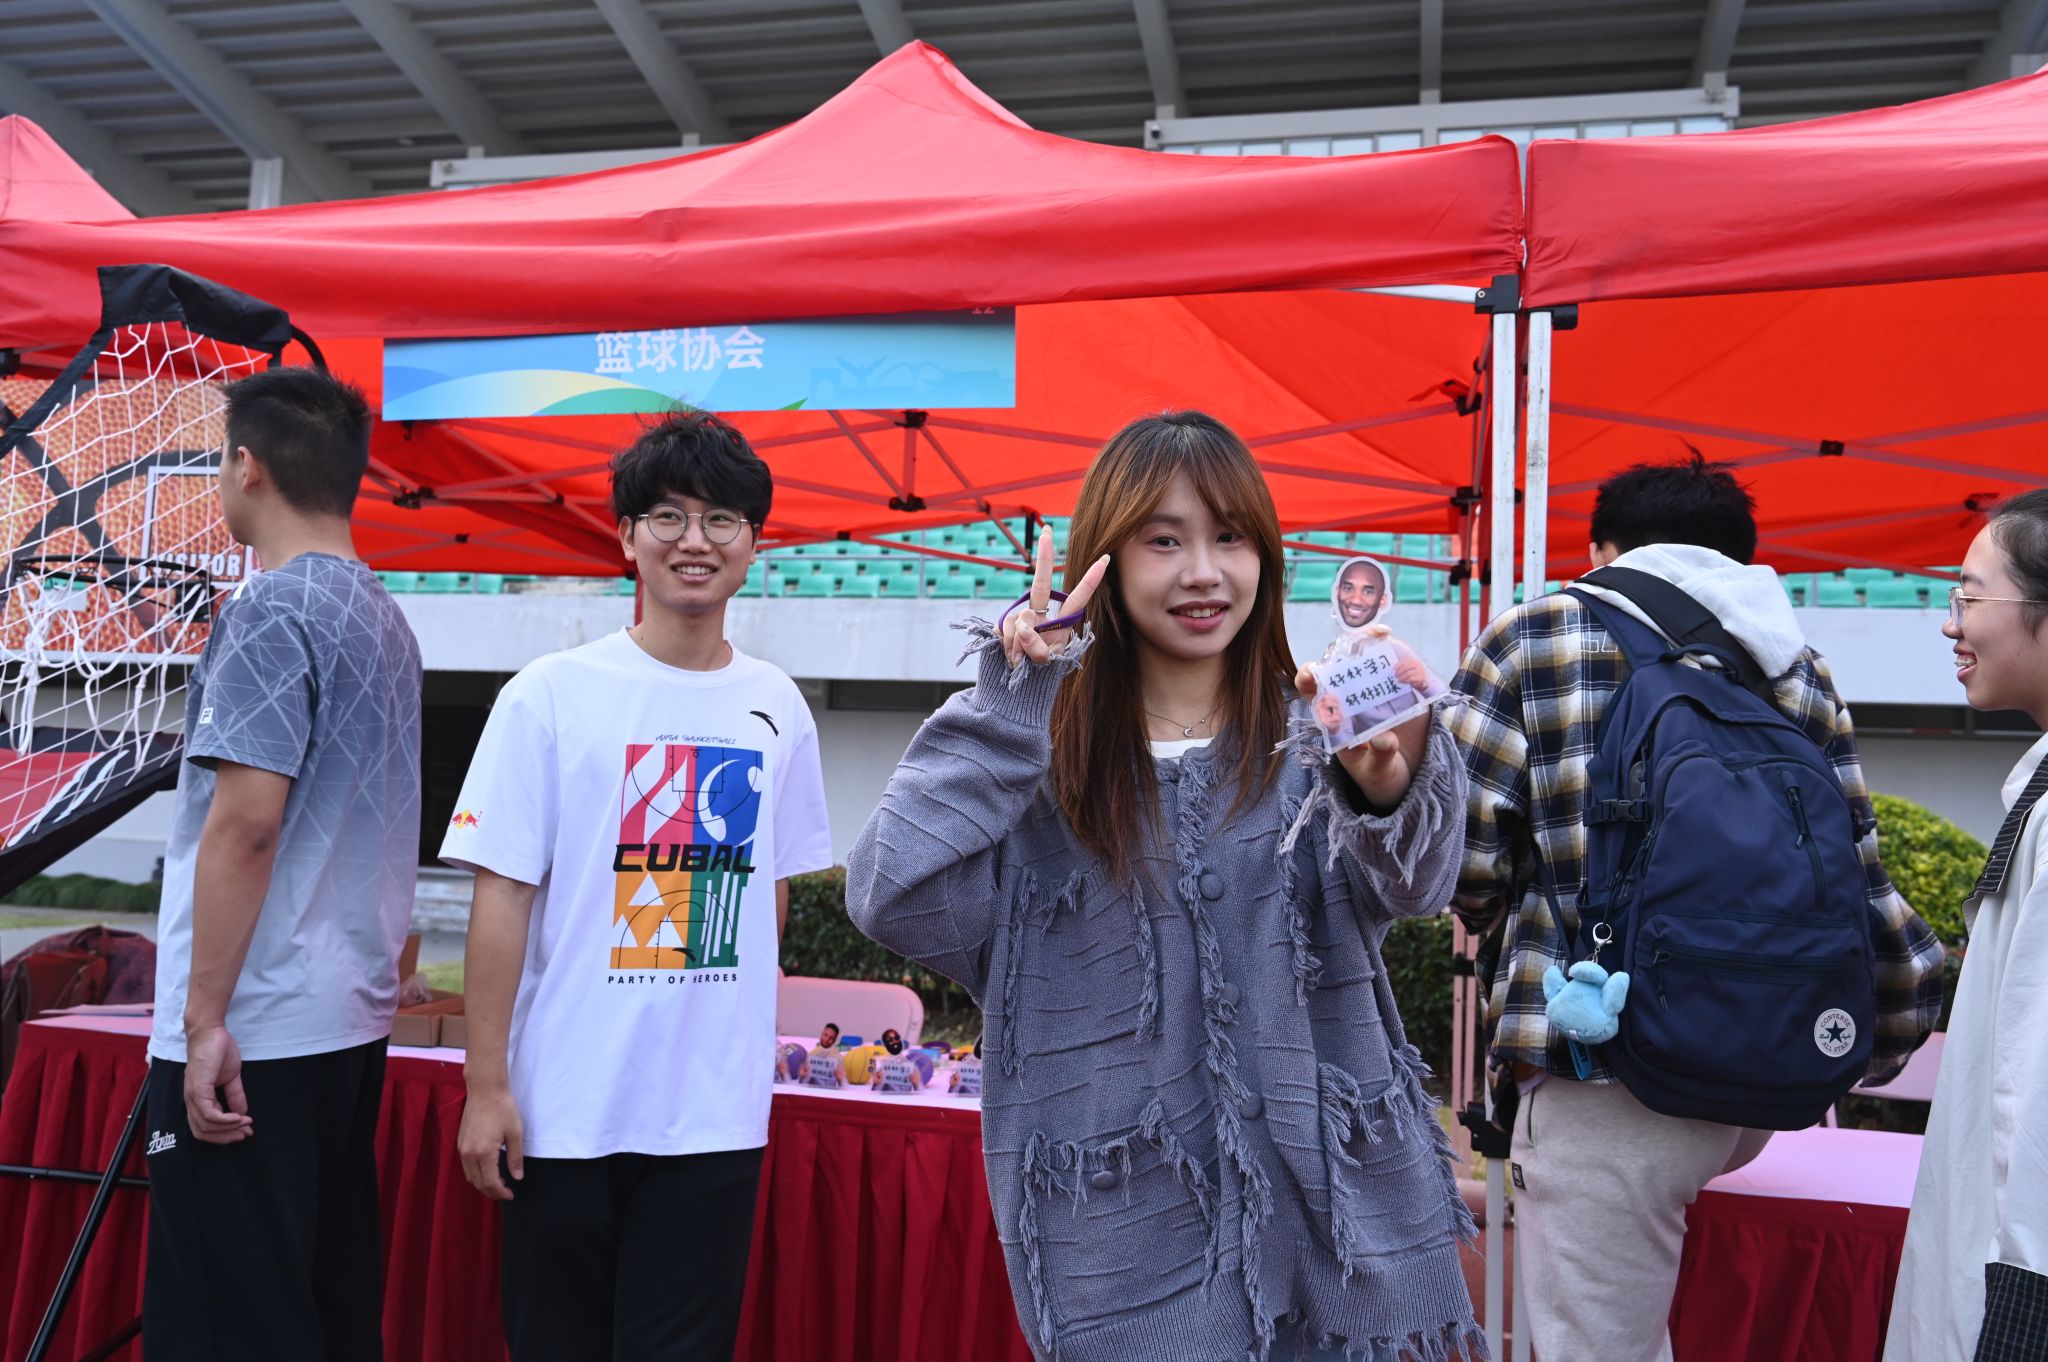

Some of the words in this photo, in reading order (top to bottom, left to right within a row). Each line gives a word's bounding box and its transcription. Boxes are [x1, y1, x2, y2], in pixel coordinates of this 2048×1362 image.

[594, 325, 766, 374] 篮球协会
[1329, 655, 1391, 688] 好好学习
[1345, 676, 1401, 707] 好好打球
[613, 844, 756, 873] CUBAL
[608, 975, 656, 985] PARTY
[668, 976, 685, 984] OF
[693, 973, 737, 984] HEROES
[1820, 1013, 1851, 1028] CONVERSE
[1822, 1041, 1832, 1052] ALL
[1833, 1041, 1849, 1053] STAR
